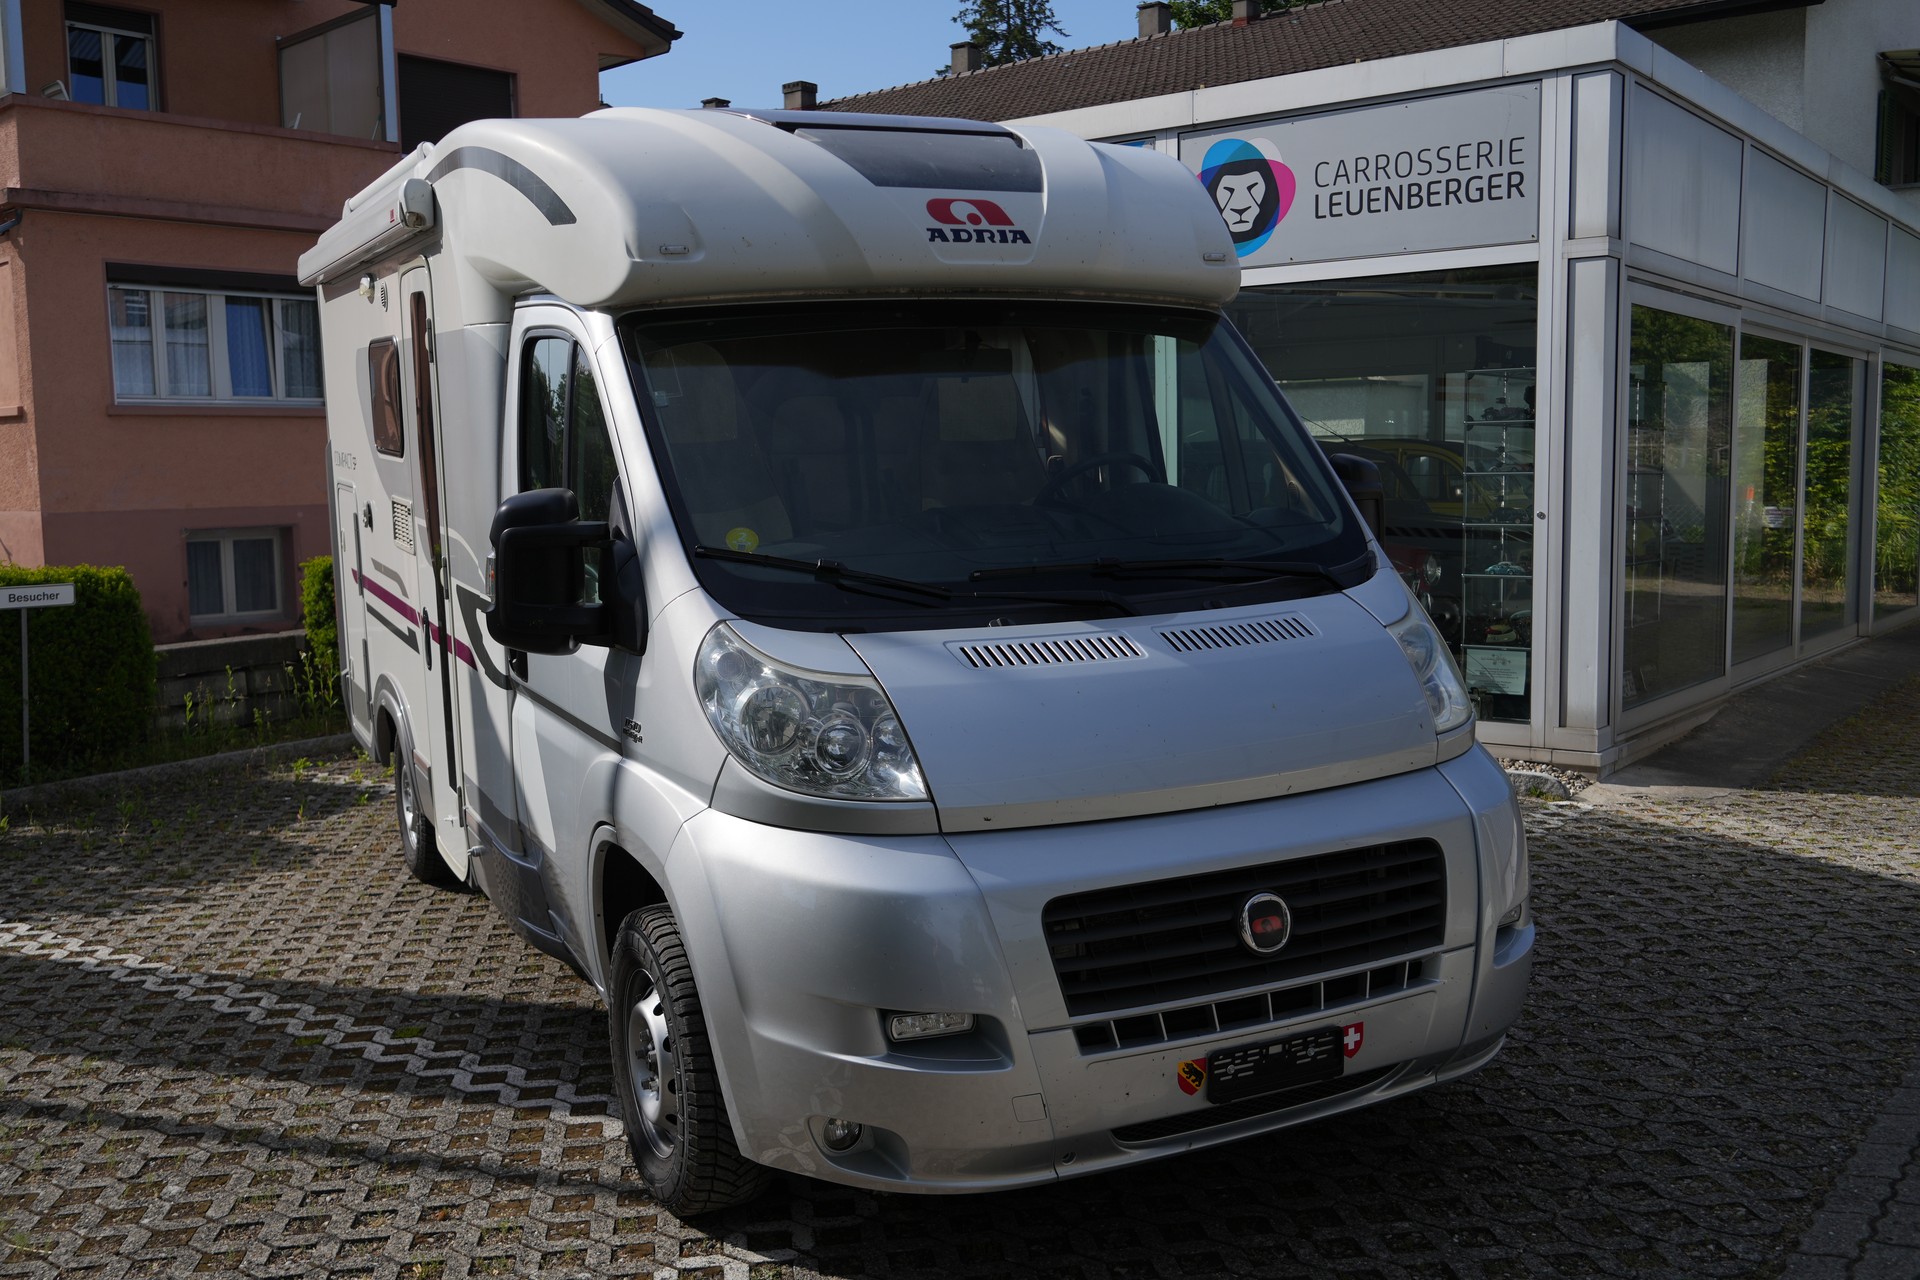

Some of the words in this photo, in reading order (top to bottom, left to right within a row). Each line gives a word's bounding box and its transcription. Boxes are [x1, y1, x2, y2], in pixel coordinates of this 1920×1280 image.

[1314, 136, 1525, 188] CARROSSERIE
[1314, 171, 1526, 219] LEUENBERGER
[926, 228, 1031, 244] ADRIA
[8, 592, 60, 603] Besucher
